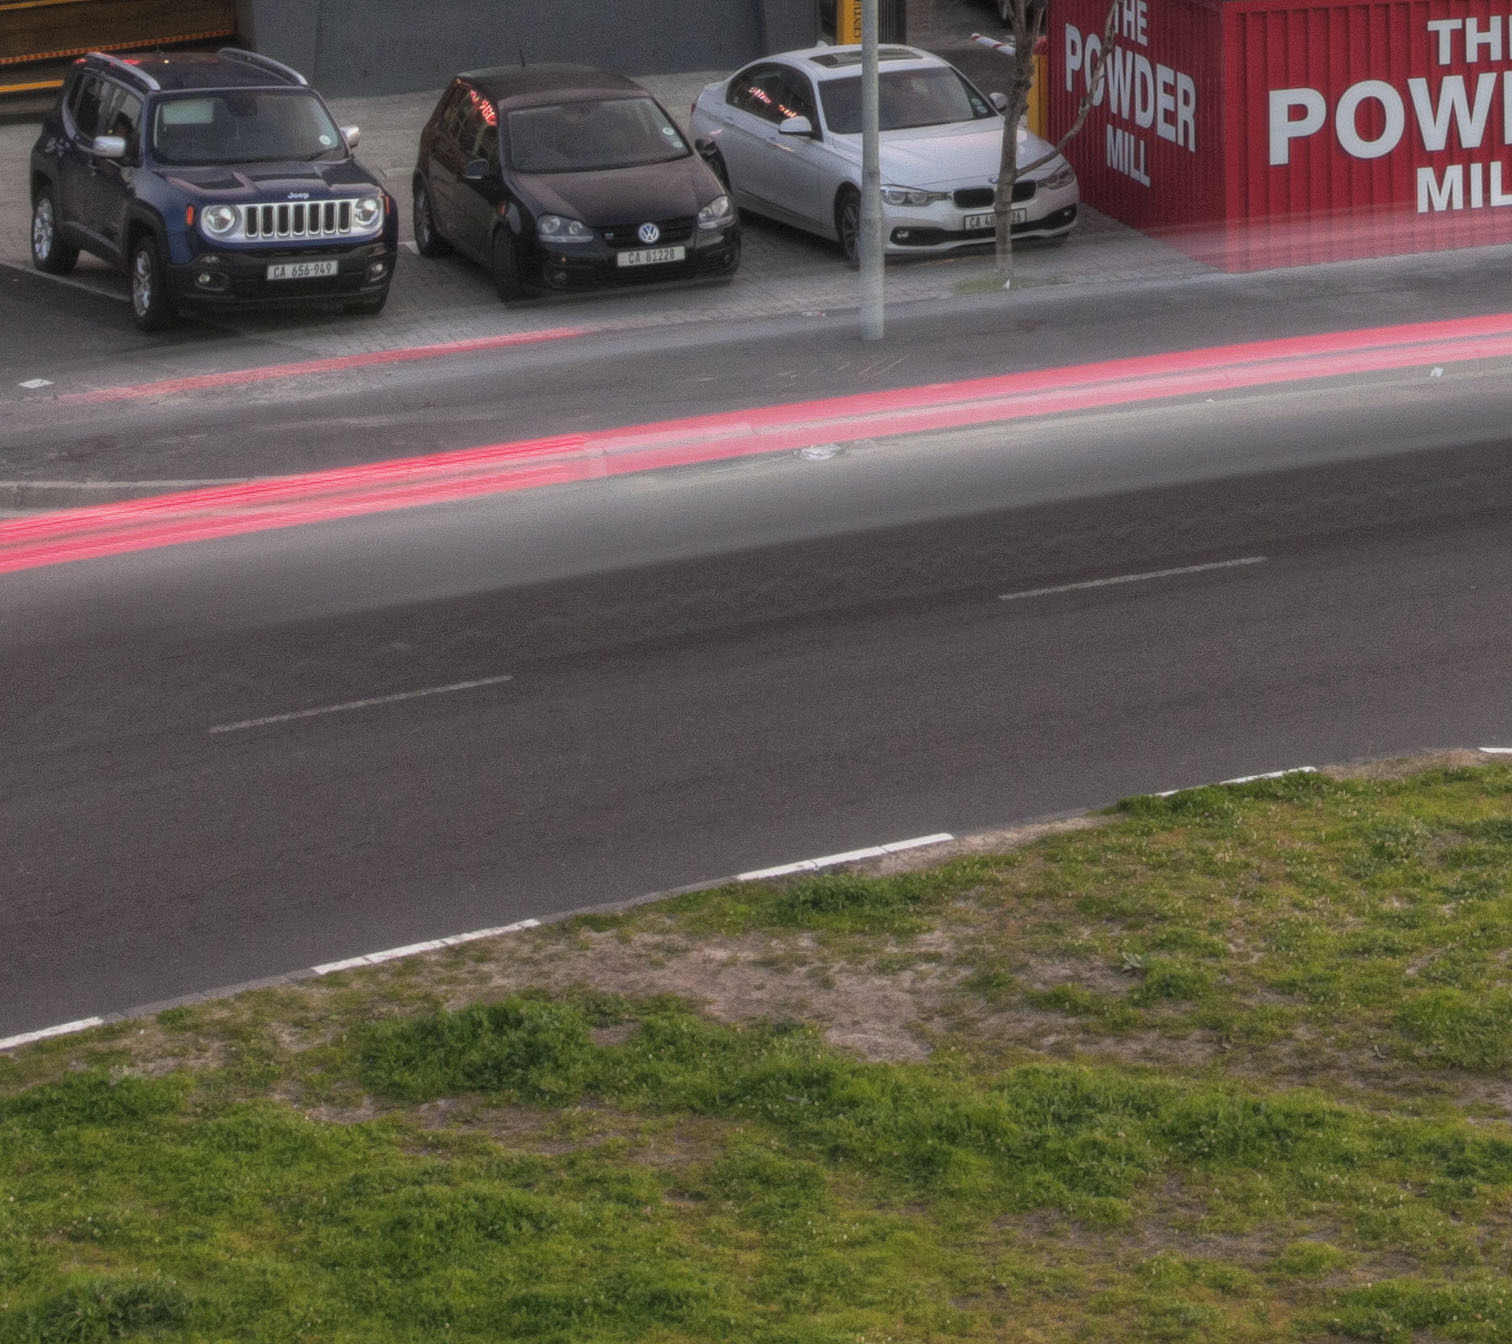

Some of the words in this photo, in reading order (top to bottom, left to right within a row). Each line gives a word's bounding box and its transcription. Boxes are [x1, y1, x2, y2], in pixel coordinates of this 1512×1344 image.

[1065, 23, 1197, 153] POWDER
[1106, 123, 1151, 188] MILL
[273, 266, 287, 278] CA
[628, 253, 641, 264] CA
